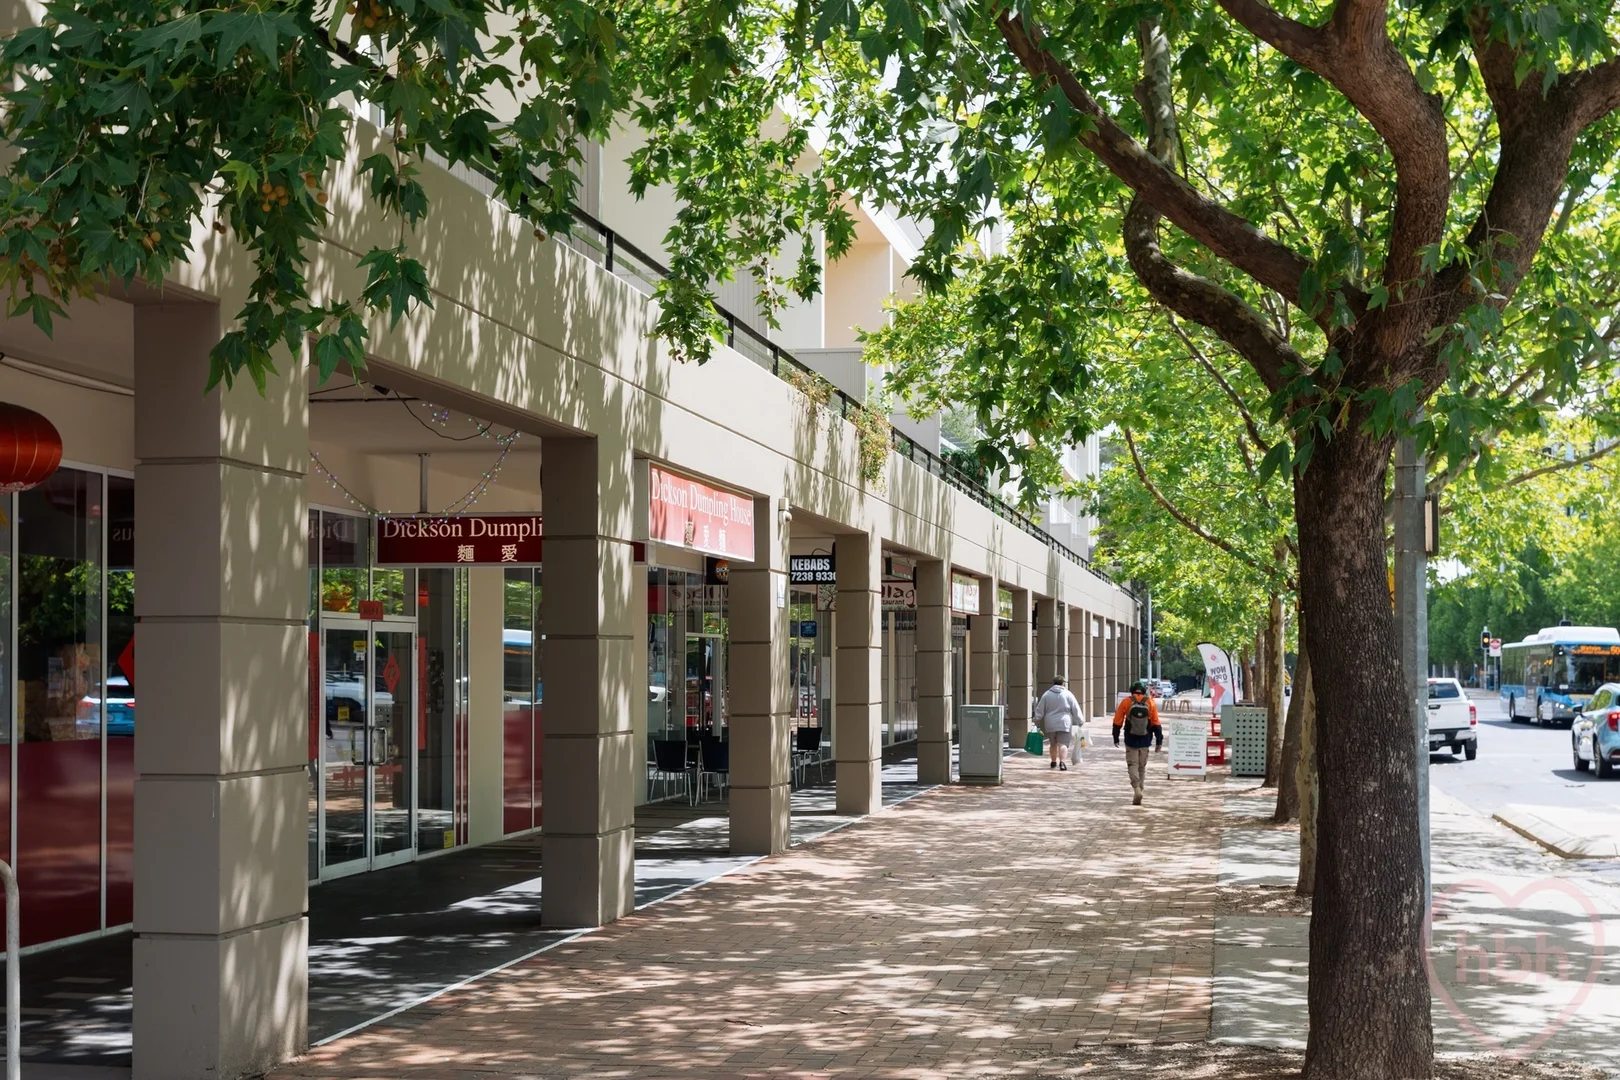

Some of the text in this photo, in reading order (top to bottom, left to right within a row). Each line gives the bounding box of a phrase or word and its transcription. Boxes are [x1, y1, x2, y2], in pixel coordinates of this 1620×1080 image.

[651, 470, 752, 526] Dickson Dumpling House
[383, 518, 463, 538] Dickson
[791, 558, 830, 571] KEBABS
[791, 571, 813, 581] 7238
